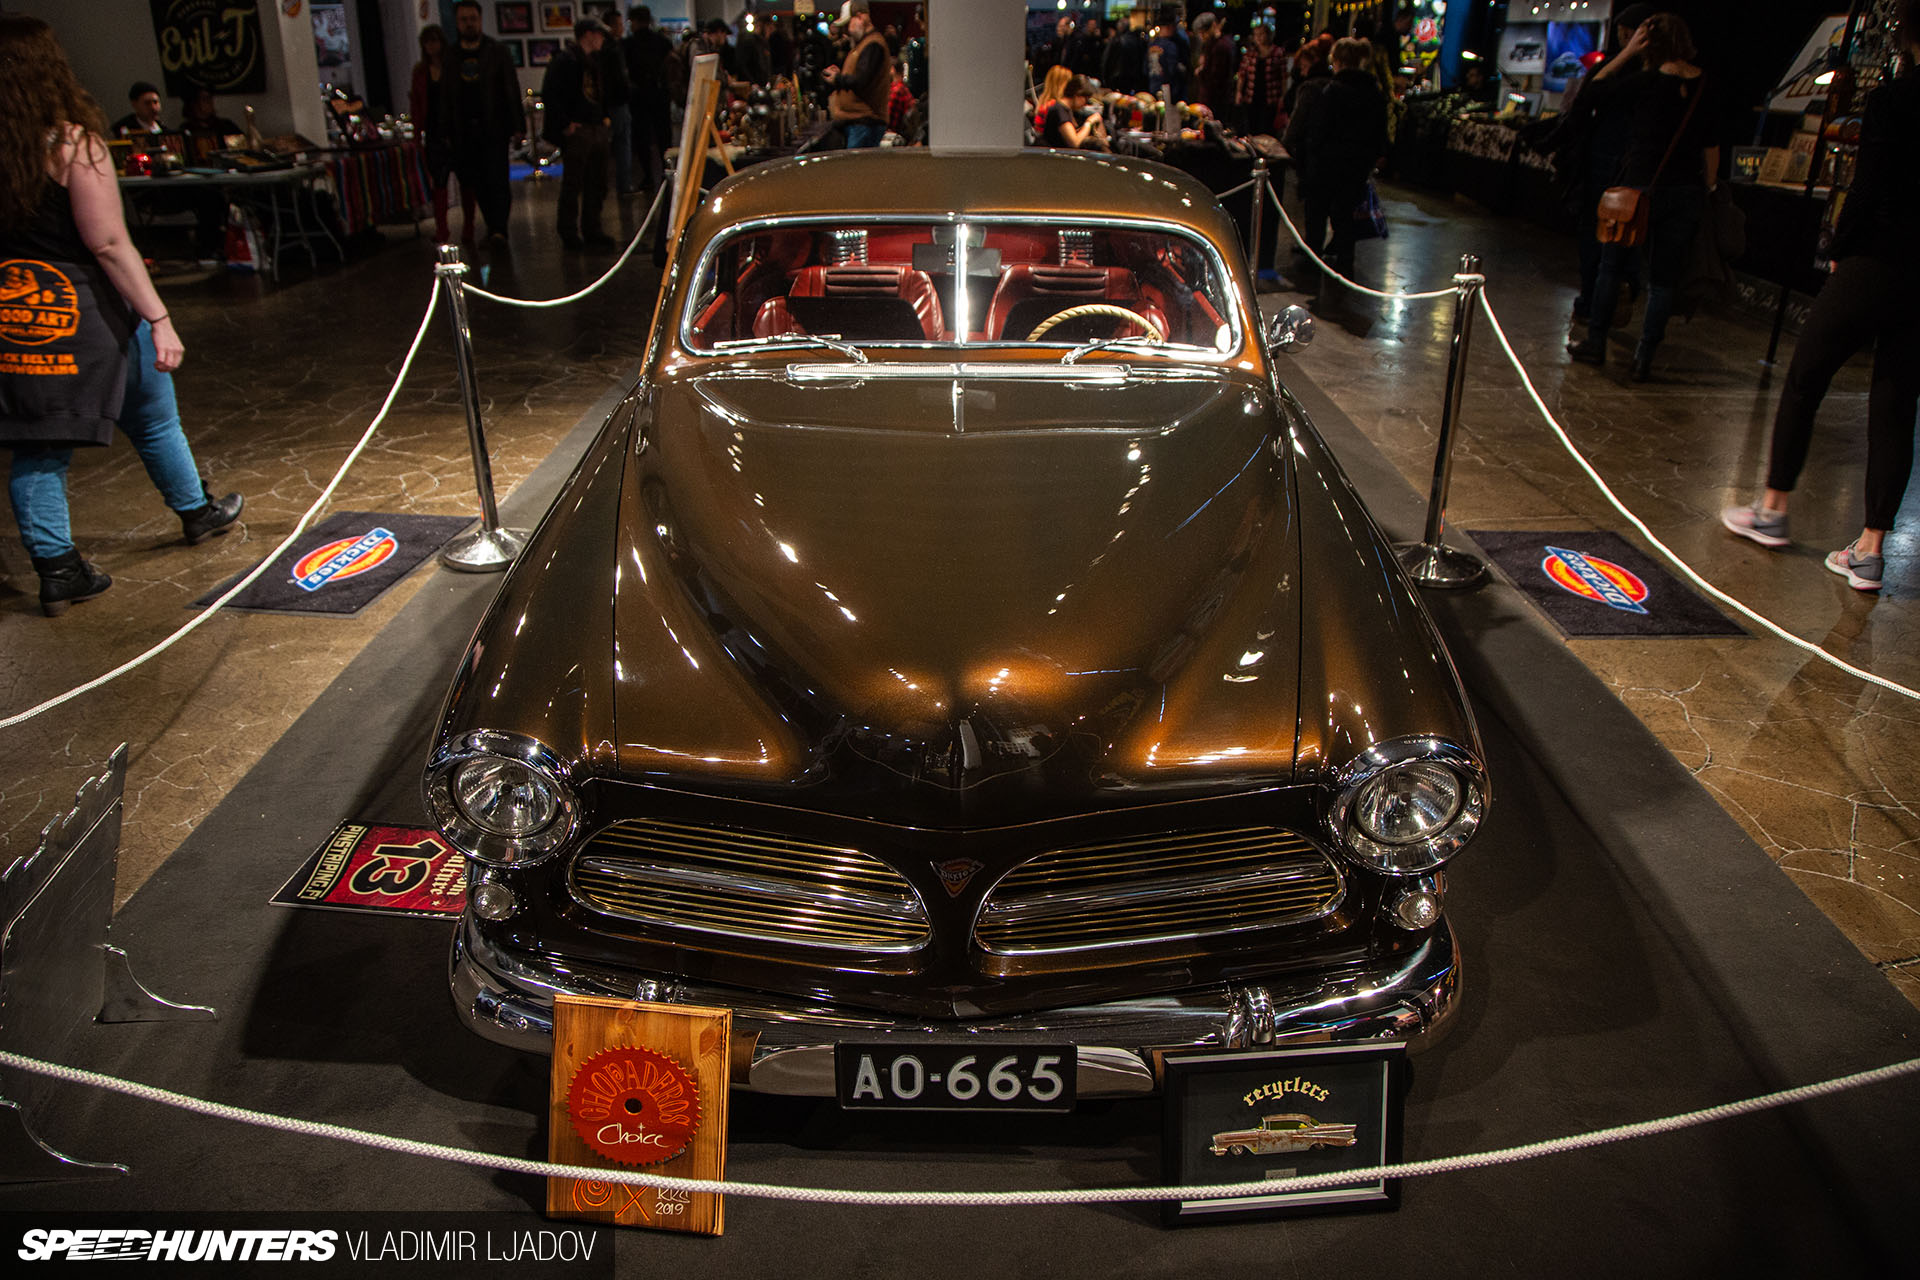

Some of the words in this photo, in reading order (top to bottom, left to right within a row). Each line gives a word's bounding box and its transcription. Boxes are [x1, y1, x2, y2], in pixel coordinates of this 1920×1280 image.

[35, 311, 72, 328] ART
[307, 532, 384, 584] Dickies
[1560, 551, 1634, 606] Dickies
[300, 824, 366, 900] PINSTRIPING.FI
[349, 838, 447, 896] 13
[579, 1060, 690, 1126] CHOPADEROS
[852, 1054, 1063, 1101] AO-665
[1243, 1076, 1331, 1106] recyclers
[655, 1201, 684, 1216] 2019
